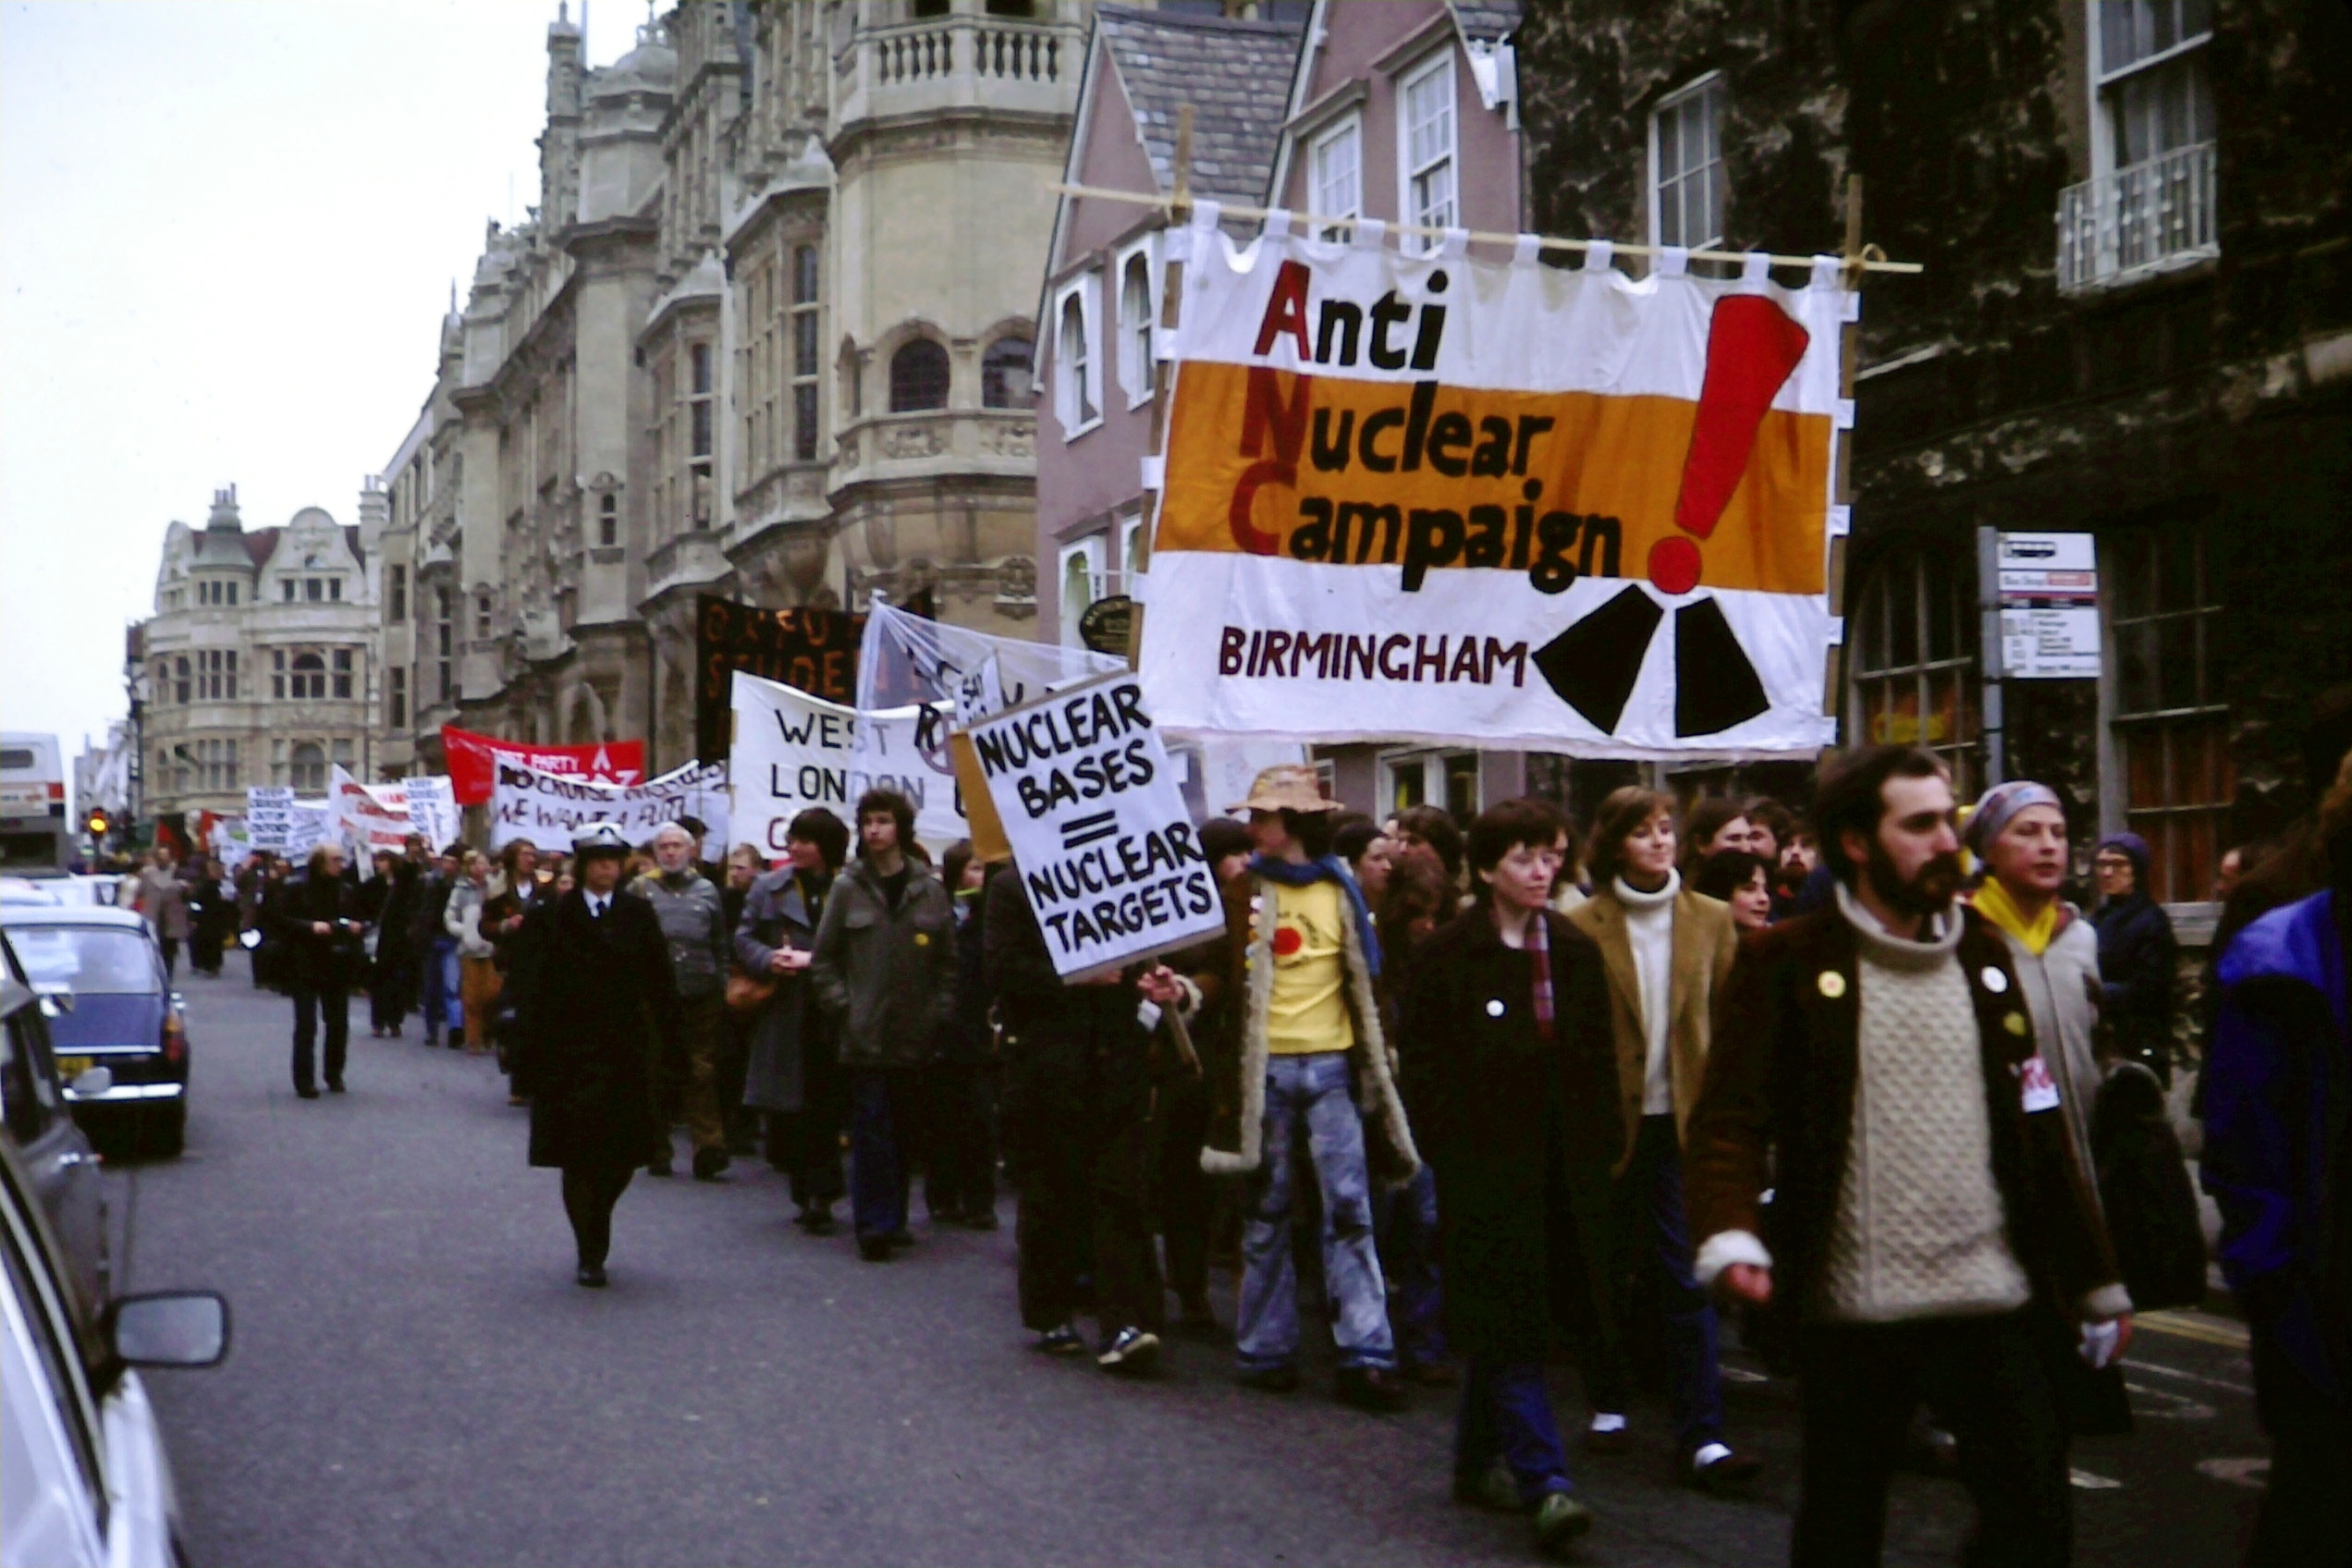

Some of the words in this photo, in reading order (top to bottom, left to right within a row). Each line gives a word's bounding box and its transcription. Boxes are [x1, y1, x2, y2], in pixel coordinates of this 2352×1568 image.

[1254, 260, 1450, 370] Anti
[1239, 365, 1554, 477] Nuclear
[1229, 462, 1622, 594] Campaign
[1219, 626, 1527, 687] BIRMINGHAM
[775, 709, 889, 755] WEST
[975, 684, 1152, 778] NUCLEAR
[771, 764, 924, 810] LONDON
[1018, 740, 1154, 818] BASES
[1026, 822, 1204, 911] NUCLEAR
[1045, 872, 1212, 953] TARGETS
